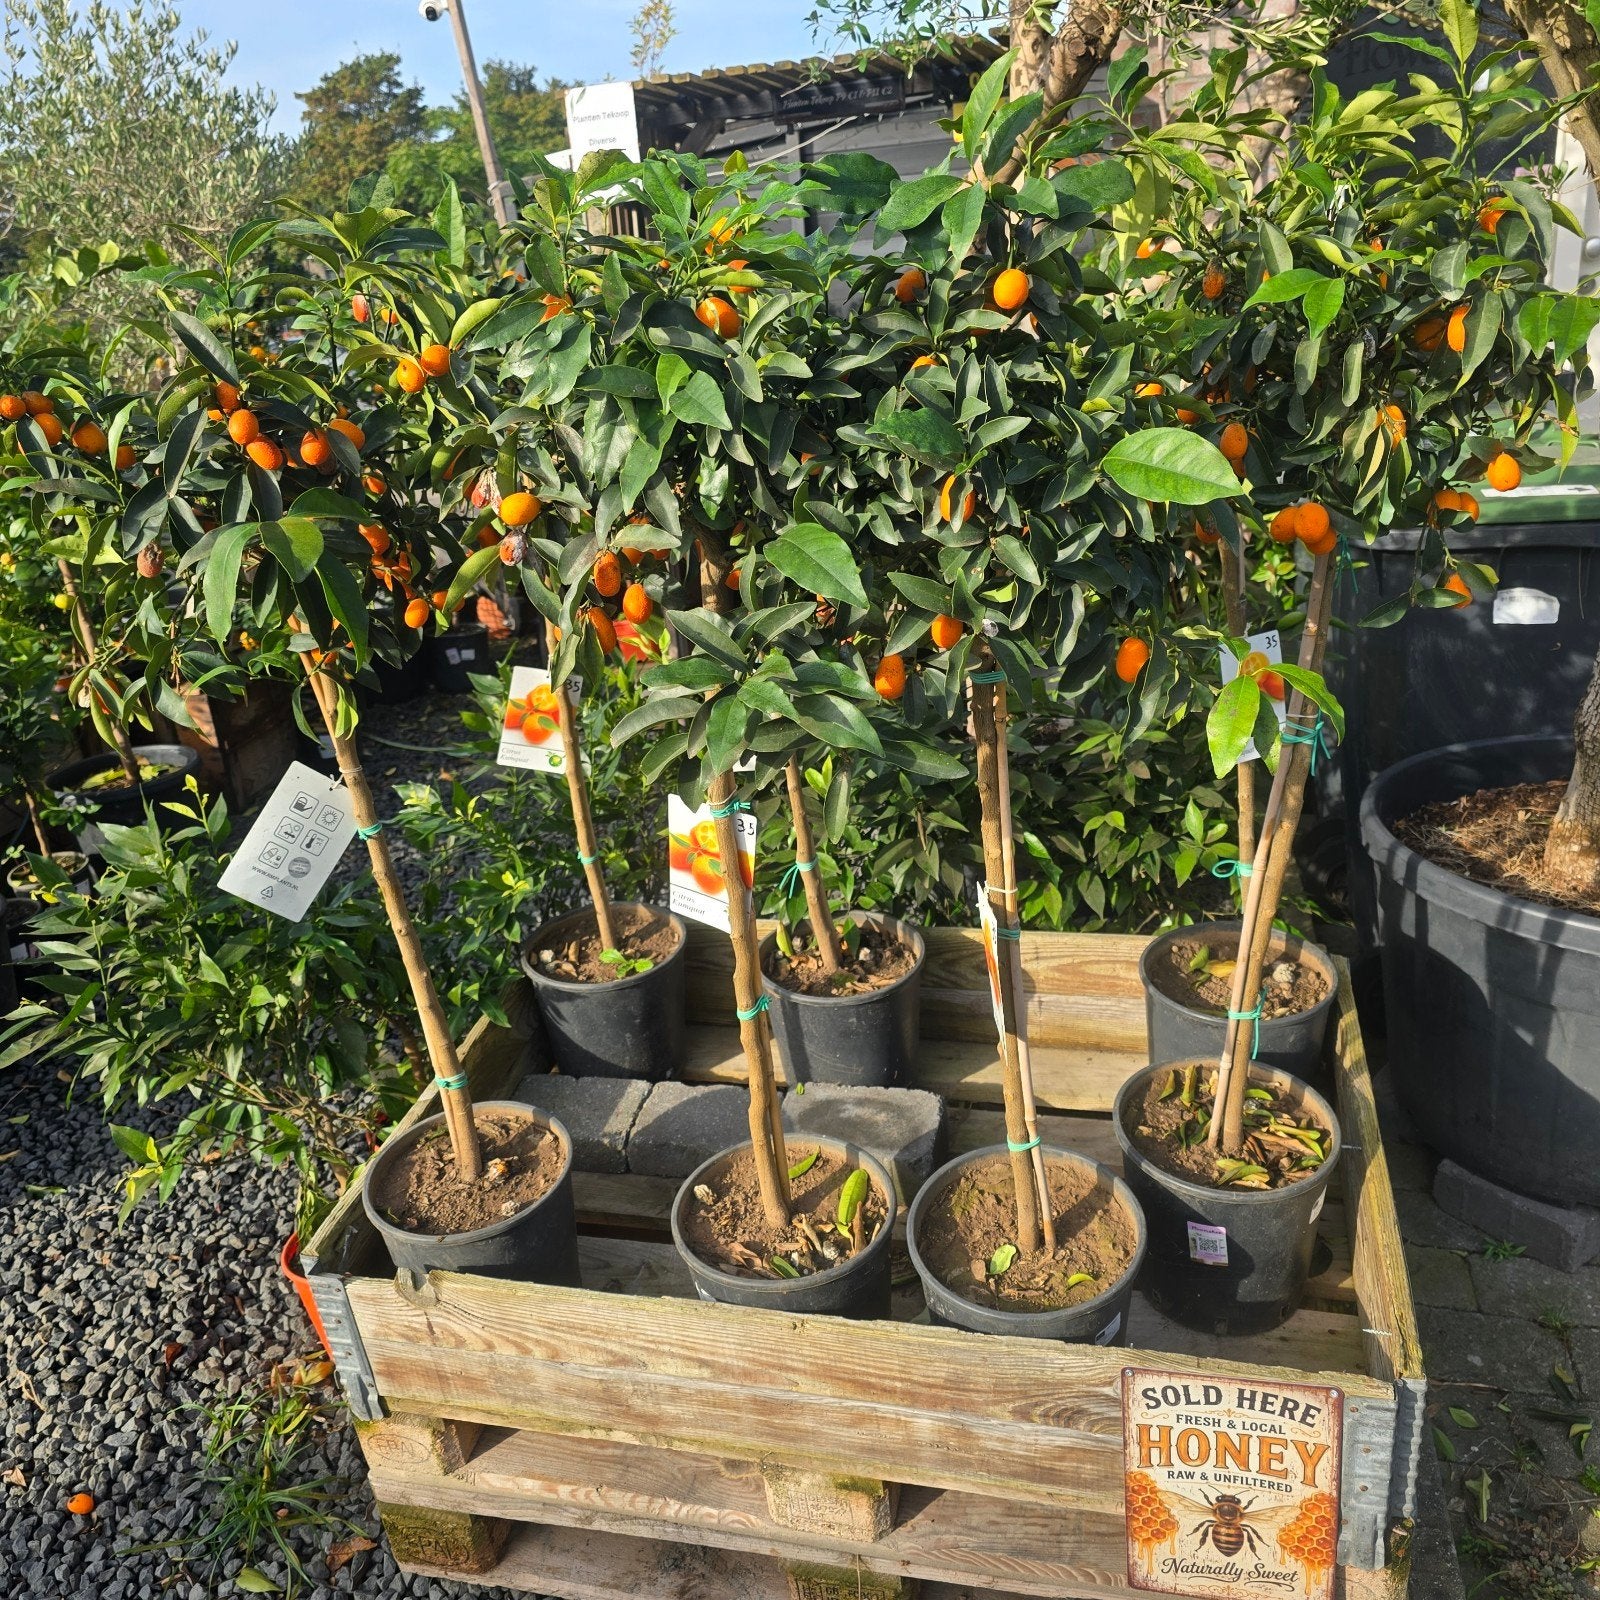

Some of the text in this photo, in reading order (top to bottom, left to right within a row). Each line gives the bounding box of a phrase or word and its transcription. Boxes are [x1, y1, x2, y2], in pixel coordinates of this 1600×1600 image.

[572, 113, 602, 123] Planten
[588, 136, 617, 146] Diverse
[1265, 635, 1278, 649] 35
[566, 679, 580, 693] 35
[501, 747, 521, 756] Citrus
[737, 818, 755, 835] 35
[672, 890, 696, 904] Citrus
[1141, 1384, 1322, 1428] SOLD HERE
[1176, 1413, 1286, 1435] FRESH & LOCAL
[1136, 1423, 1330, 1489] HONEY
[1167, 1470, 1293, 1493] RAW & UNFILTERED
[1161, 1557, 1299, 1584] Naturally Sweet
